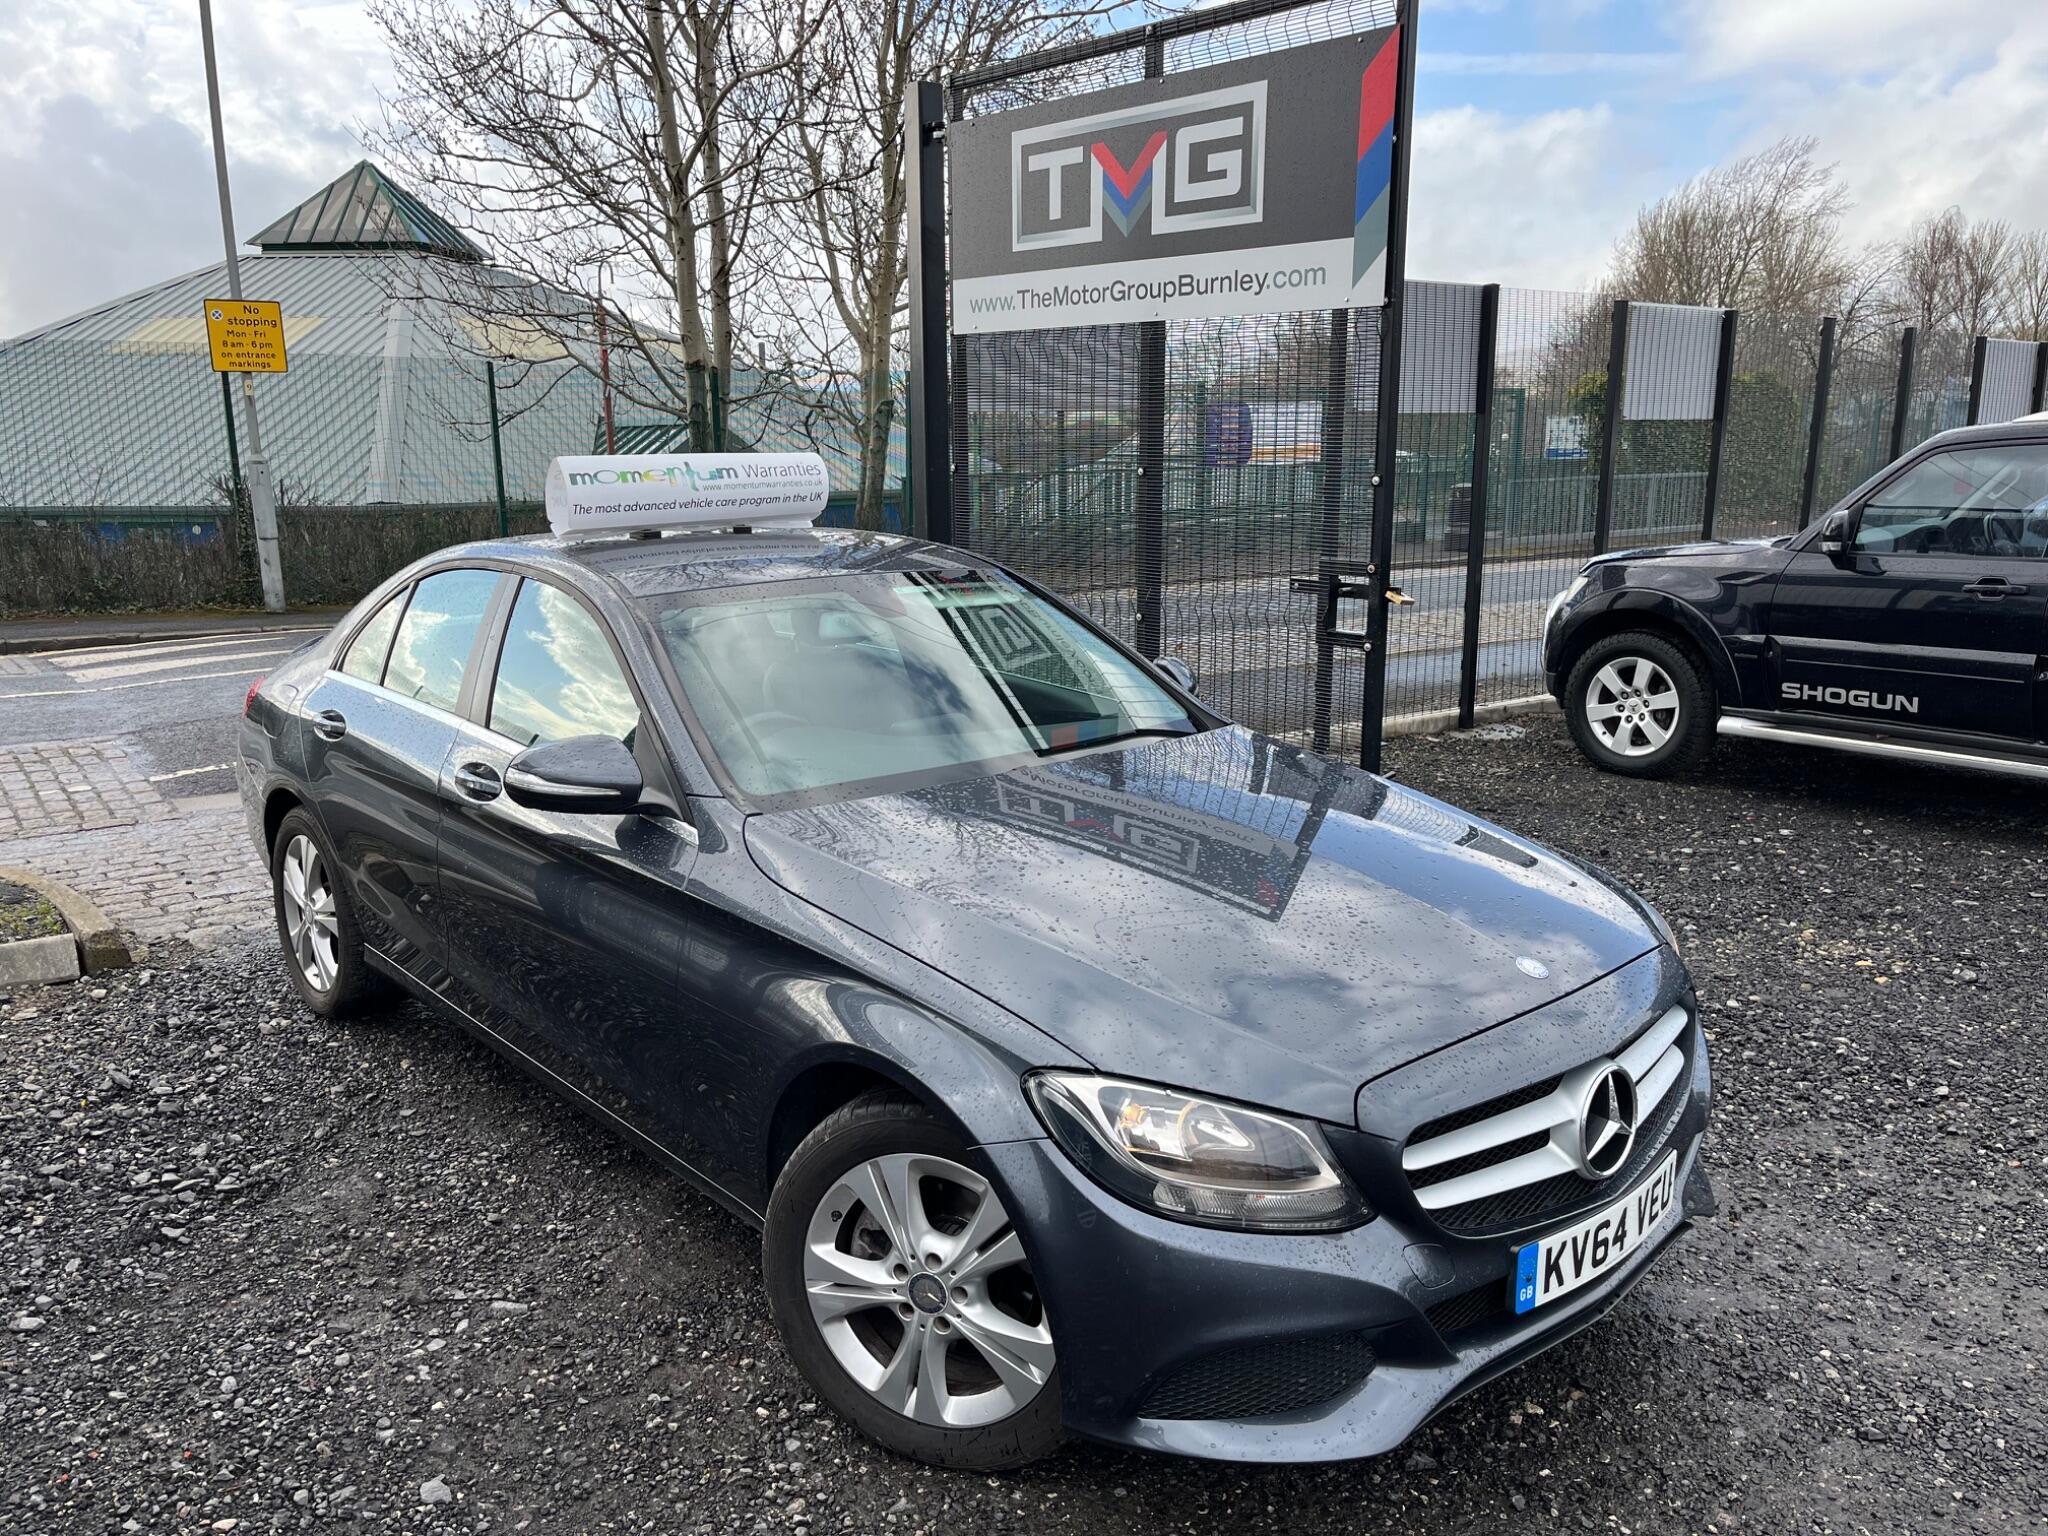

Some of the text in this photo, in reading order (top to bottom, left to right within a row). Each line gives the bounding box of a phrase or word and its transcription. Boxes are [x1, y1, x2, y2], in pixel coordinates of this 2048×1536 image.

[1028, 116, 1244, 238] TMG
[969, 265, 1327, 314] www.TheMotorGroupBurnley.com
[243, 305, 259, 315] No
[227, 317, 277, 328] stopping
[226, 330, 247, 338] Mon
[221, 351, 233, 359] on
[229, 361, 271, 369] markings
[568, 461, 739, 492] momentum
[741, 462, 821, 478] Warranties
[573, 491, 824, 515] The most advanced vehicle care program in the UK
[1781, 682, 1919, 713] SHOGUN
[1543, 1207, 1628, 1295] KV64
[1519, 1286, 1533, 1301] GB
